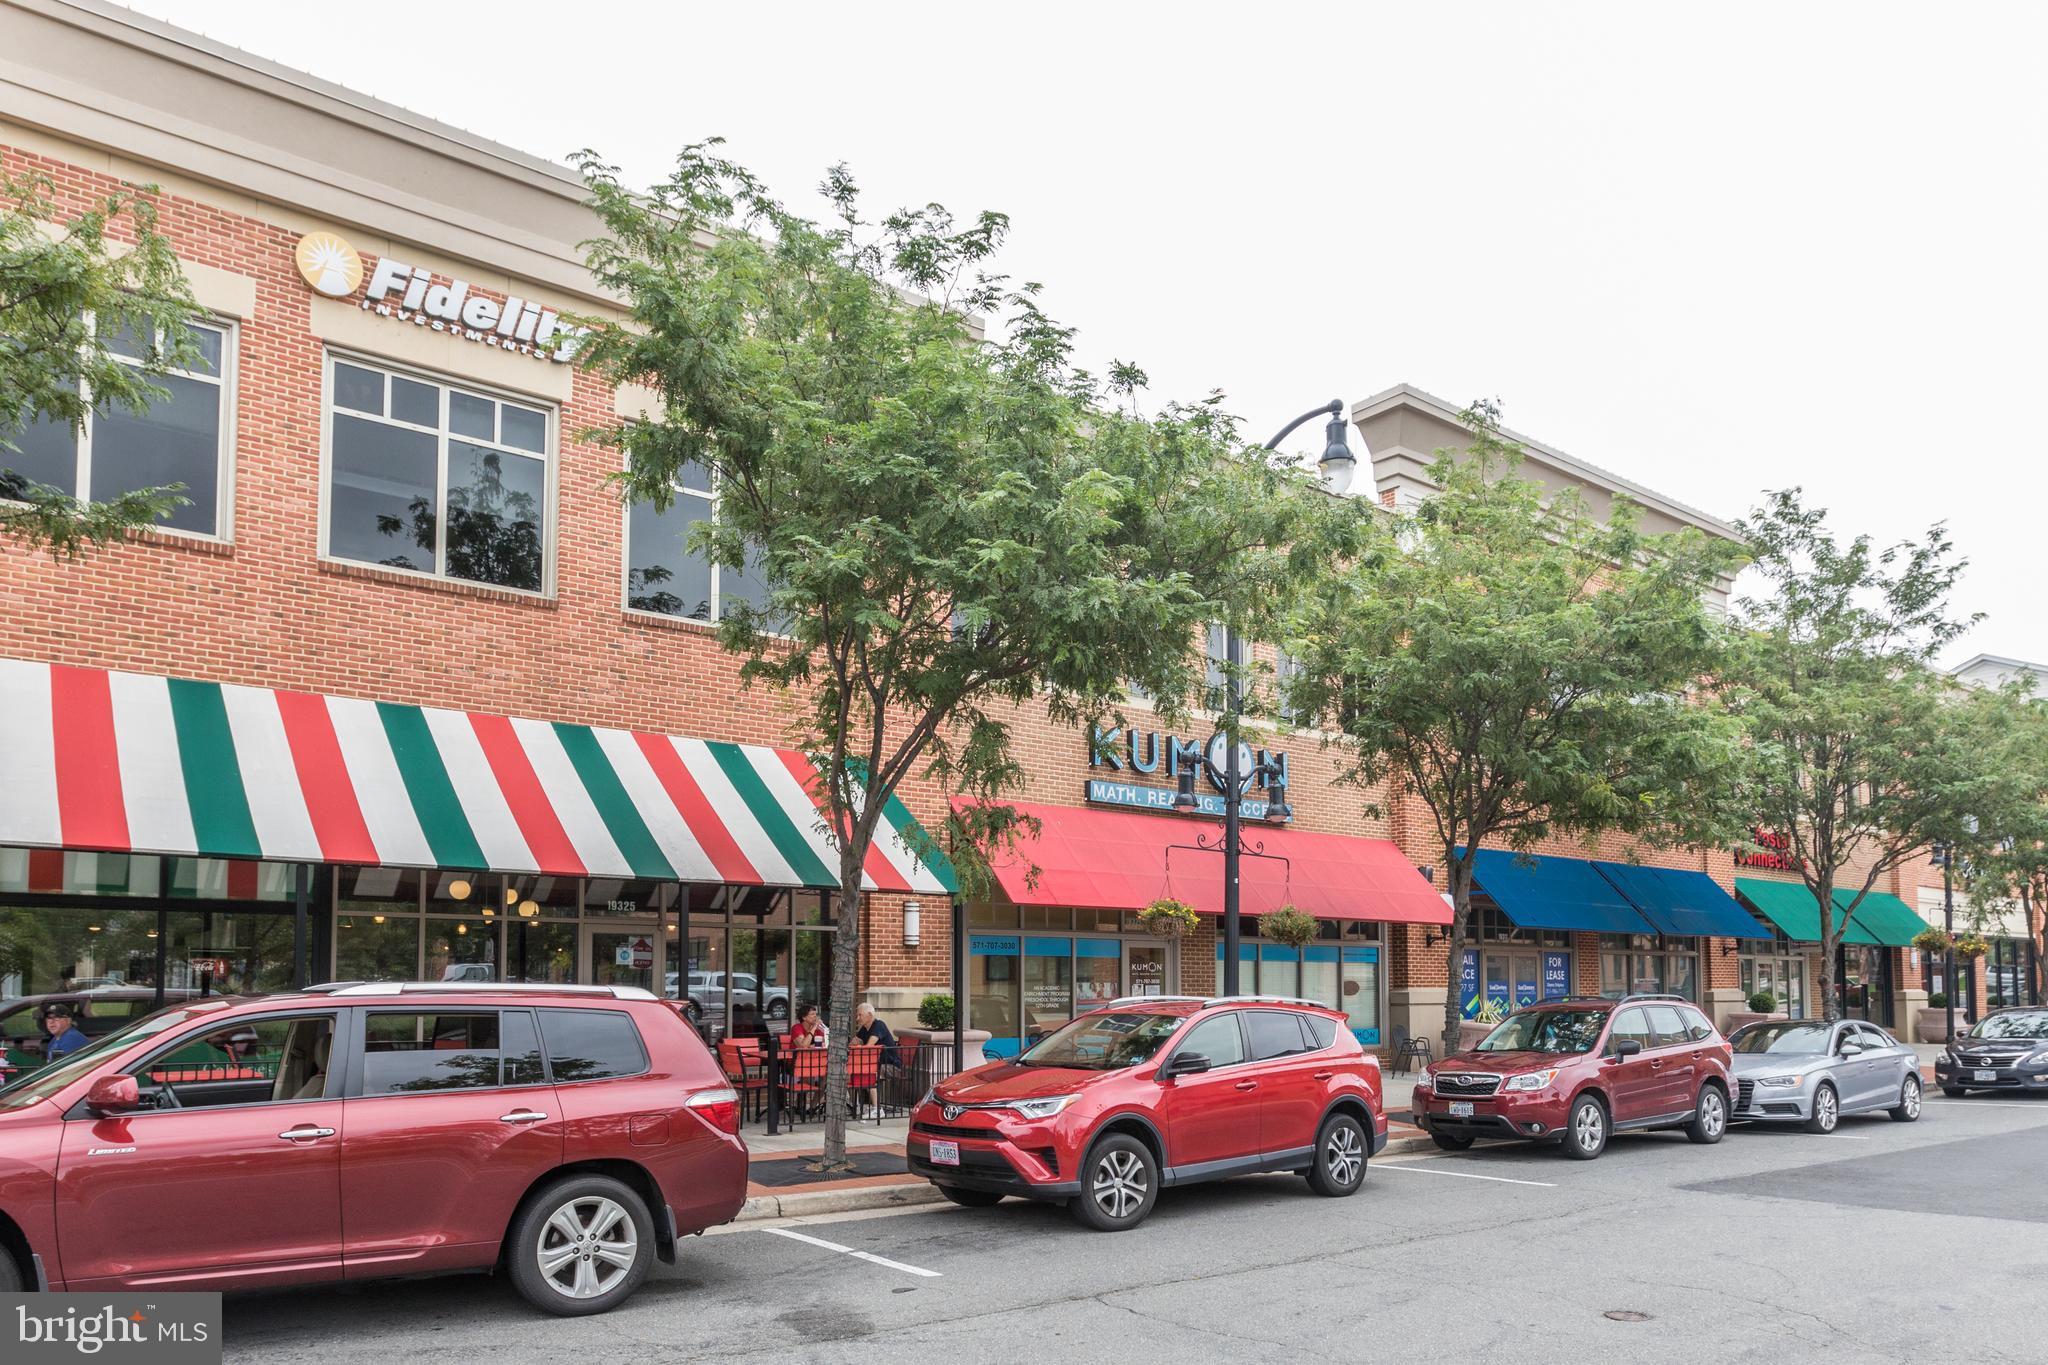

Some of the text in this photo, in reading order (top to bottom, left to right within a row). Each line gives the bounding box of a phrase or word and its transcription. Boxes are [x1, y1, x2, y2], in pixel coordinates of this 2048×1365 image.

[366, 256, 592, 362] Fidelity
[362, 300, 546, 360] INVESTMENTS
[1093, 783, 1141, 802] MATH.
[607, 900, 636, 912] 19325
[1131, 961, 1162, 973] KUMON
[1548, 957, 1562, 968] FOR
[1545, 970, 1565, 981] LEASE
[87, 1147, 137, 1156] LIMITED
